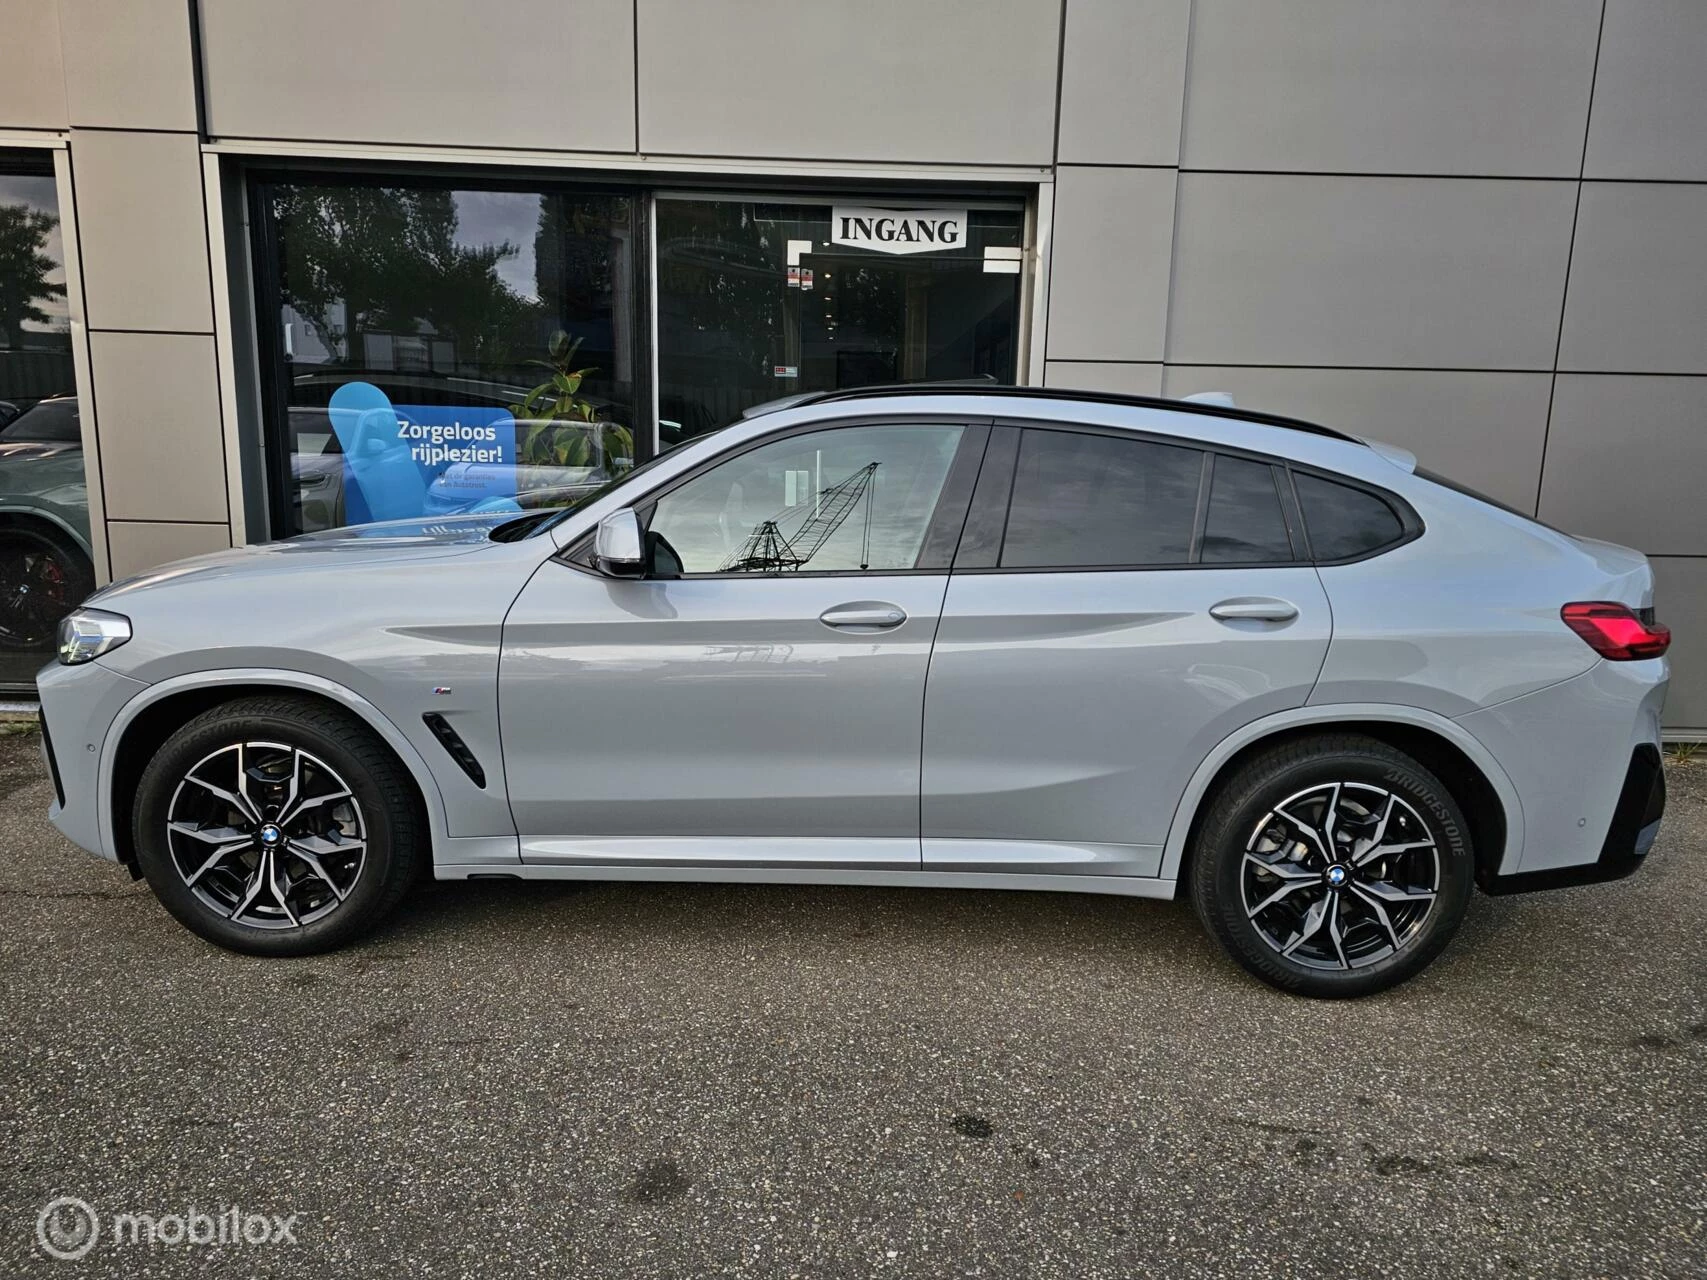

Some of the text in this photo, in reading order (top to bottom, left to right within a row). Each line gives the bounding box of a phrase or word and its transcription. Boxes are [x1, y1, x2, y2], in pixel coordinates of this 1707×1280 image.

[840, 217, 959, 243] INGANG
[397, 421, 497, 444] Zorgeloos
[411, 443, 503, 466] rijplezier!
[1383, 768, 1466, 857] BRIDGESTONE
